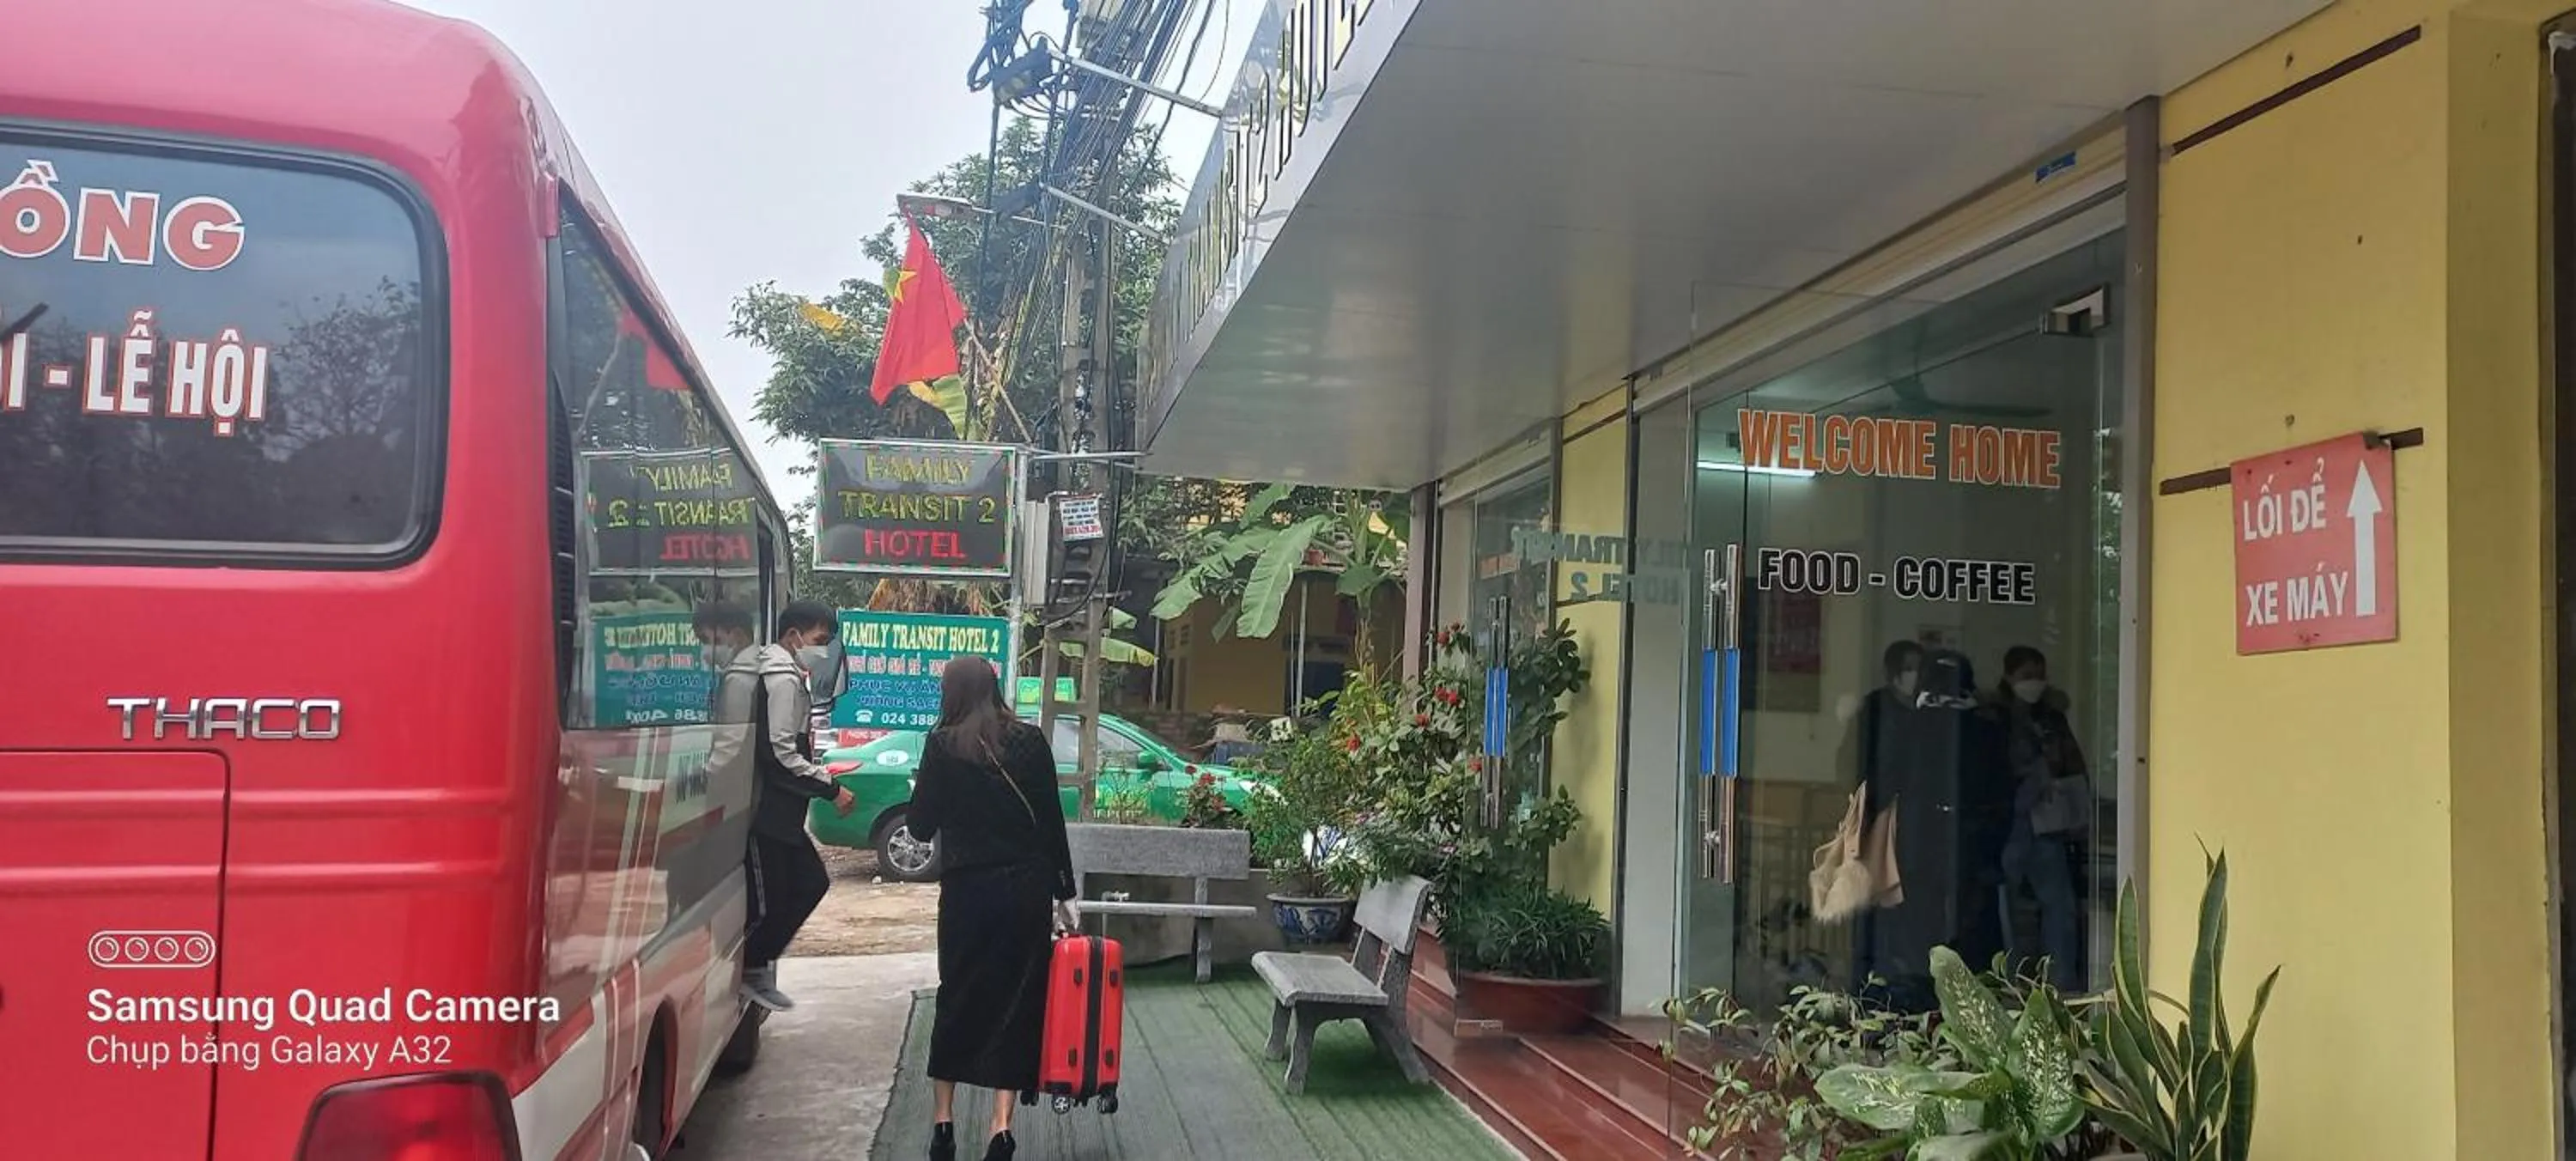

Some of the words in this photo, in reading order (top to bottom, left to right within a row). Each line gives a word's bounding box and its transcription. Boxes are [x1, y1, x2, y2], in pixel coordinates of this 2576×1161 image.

[83, 309, 155, 415] LỄ
[166, 327, 268, 437] HỘI
[865, 453, 970, 484] FAMILY
[1738, 408, 1936, 480] WELCOME
[1949, 424, 2061, 489] HOME
[838, 490, 972, 523] TRANSIT
[977, 495, 997, 524] 2
[2243, 474, 2282, 541] LỐI
[2290, 457, 2327, 533] ĐỂ
[865, 529, 968, 558] HOTEL
[1759, 548, 1861, 595] FOOD
[1868, 572, 1886, 587] -
[1893, 556, 2036, 605] COFFEE
[2246, 581, 2279, 627] XE
[2287, 562, 2348, 621] MÁY
[842, 622, 890, 649] FAMILY
[892, 624, 946, 651] TRANSIT
[949, 627, 987, 653] HOTEL
[988, 629, 999, 653] 2
[106, 697, 341, 740] THACO
[881, 712, 906, 724] 024
[910, 714, 939, 726] 388
